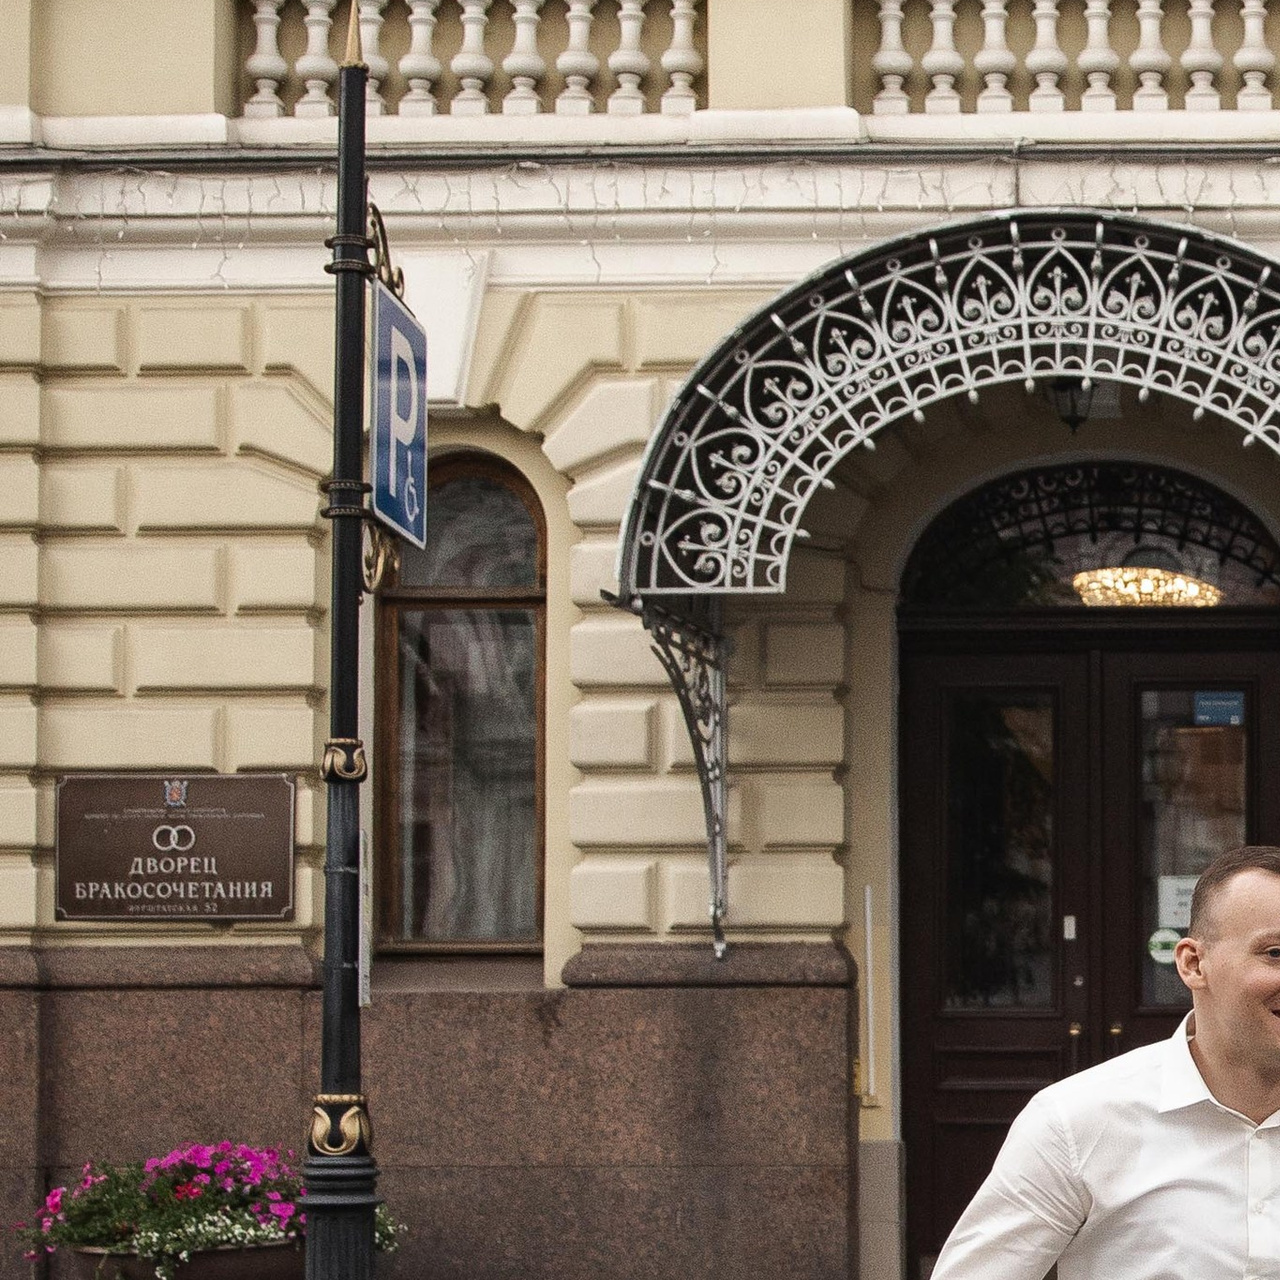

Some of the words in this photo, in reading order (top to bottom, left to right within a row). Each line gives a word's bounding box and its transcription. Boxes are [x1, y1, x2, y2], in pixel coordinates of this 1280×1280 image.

[389, 325, 418, 497] P
[128, 857, 218, 875] ДВОРЕЦ
[75, 881, 273, 900] БРАКОСОЧЕТАНИЯ
